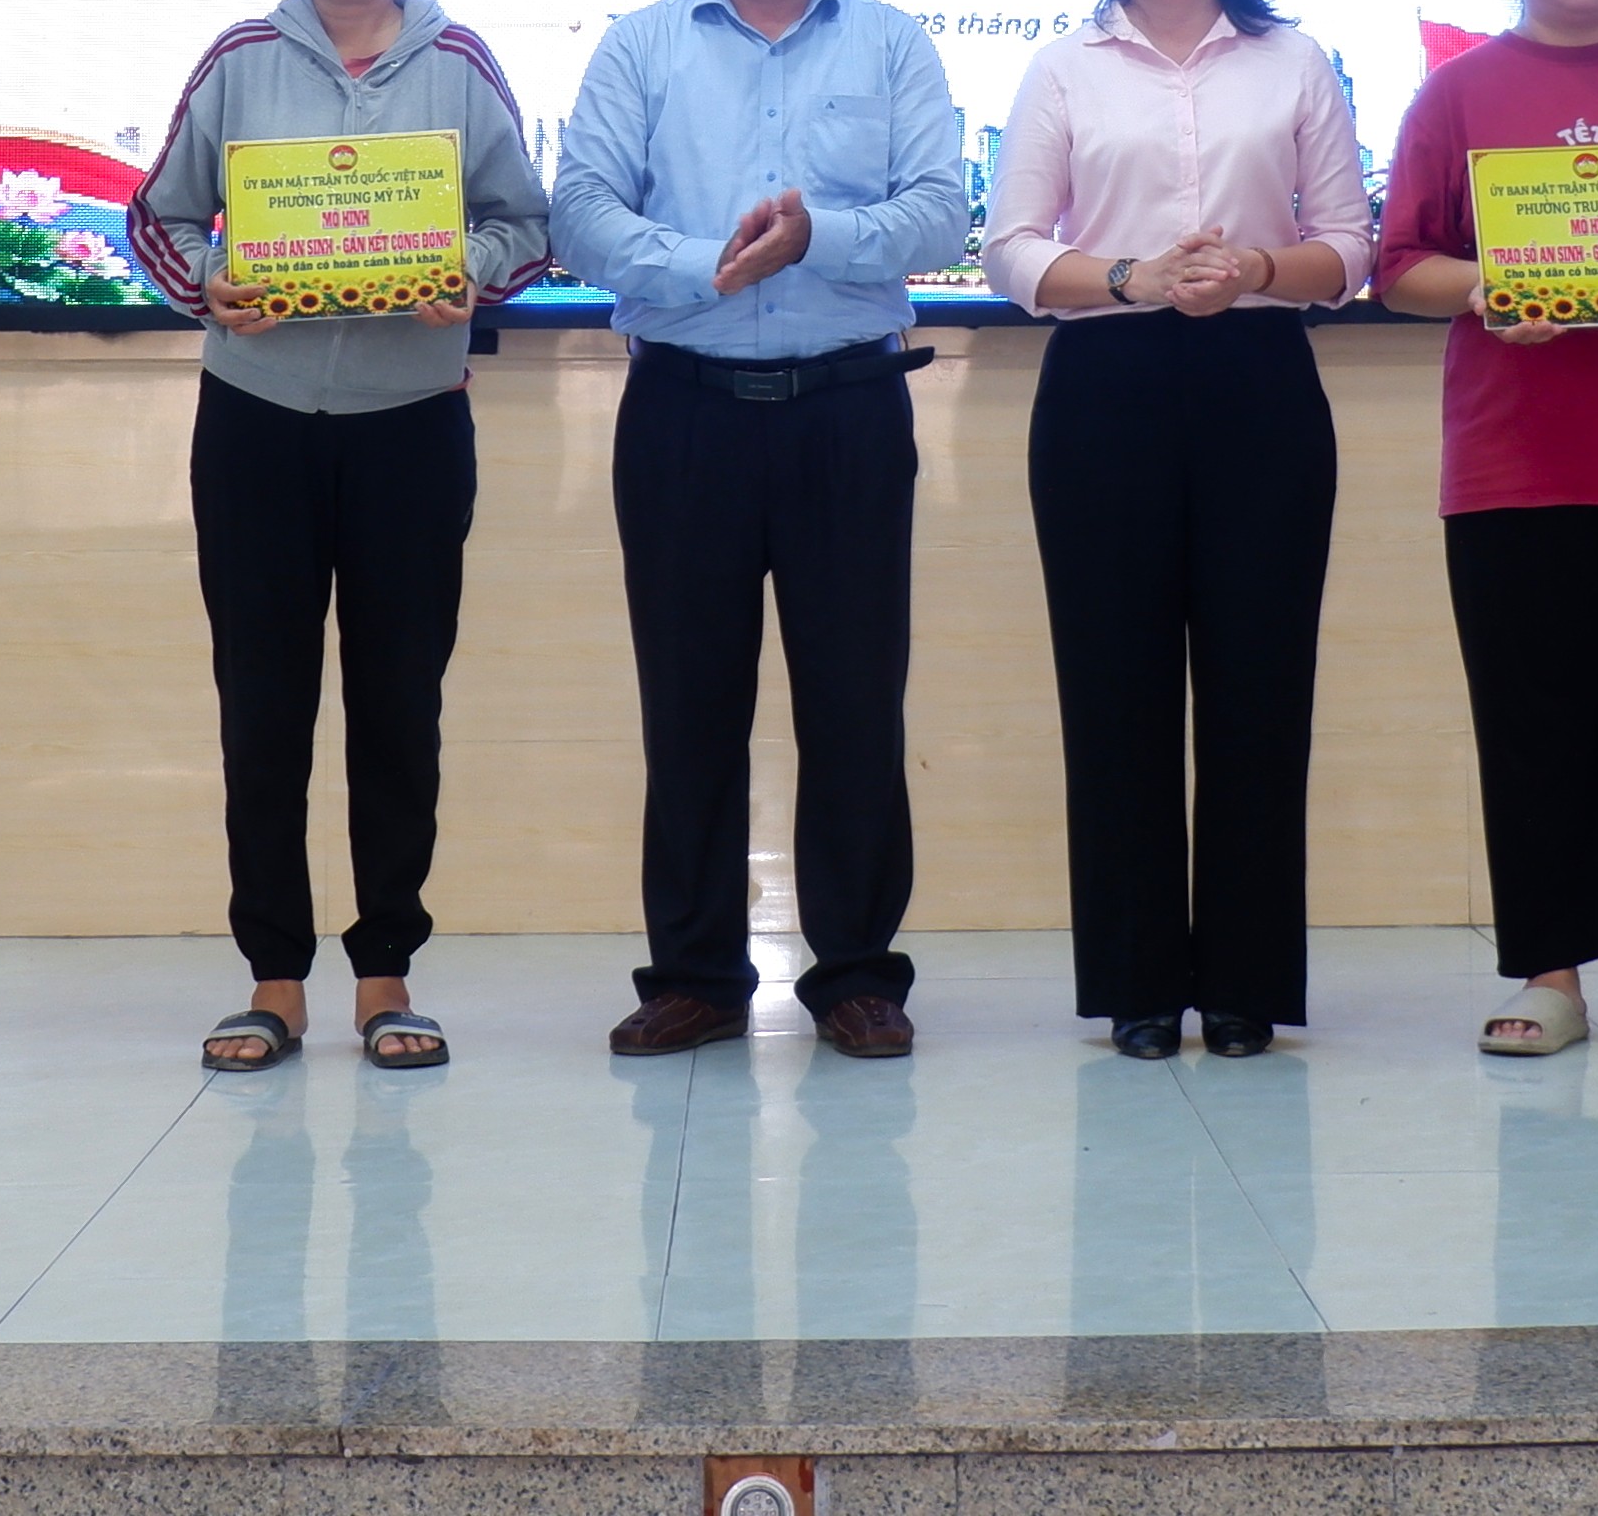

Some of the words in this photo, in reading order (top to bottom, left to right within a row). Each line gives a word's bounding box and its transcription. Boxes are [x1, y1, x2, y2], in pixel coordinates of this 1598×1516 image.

[957, 11, 1041, 41] tháng
[1053, 11, 1069, 35] 6
[261, 177, 284, 189] BAN
[418, 169, 444, 181] NAM
[326, 191, 372, 206] TRUNG
[373, 187, 394, 203] MỸ
[396, 186, 421, 202] TÂY
[1506, 185, 1530, 196] BAN
[288, 239, 306, 258] AN
[306, 237, 334, 257] SINH
[1539, 245, 1557, 263] AN
[1557, 244, 1585, 263] SINH
[251, 262, 273, 274] Cho
[1504, 267, 1526, 279] Cho
